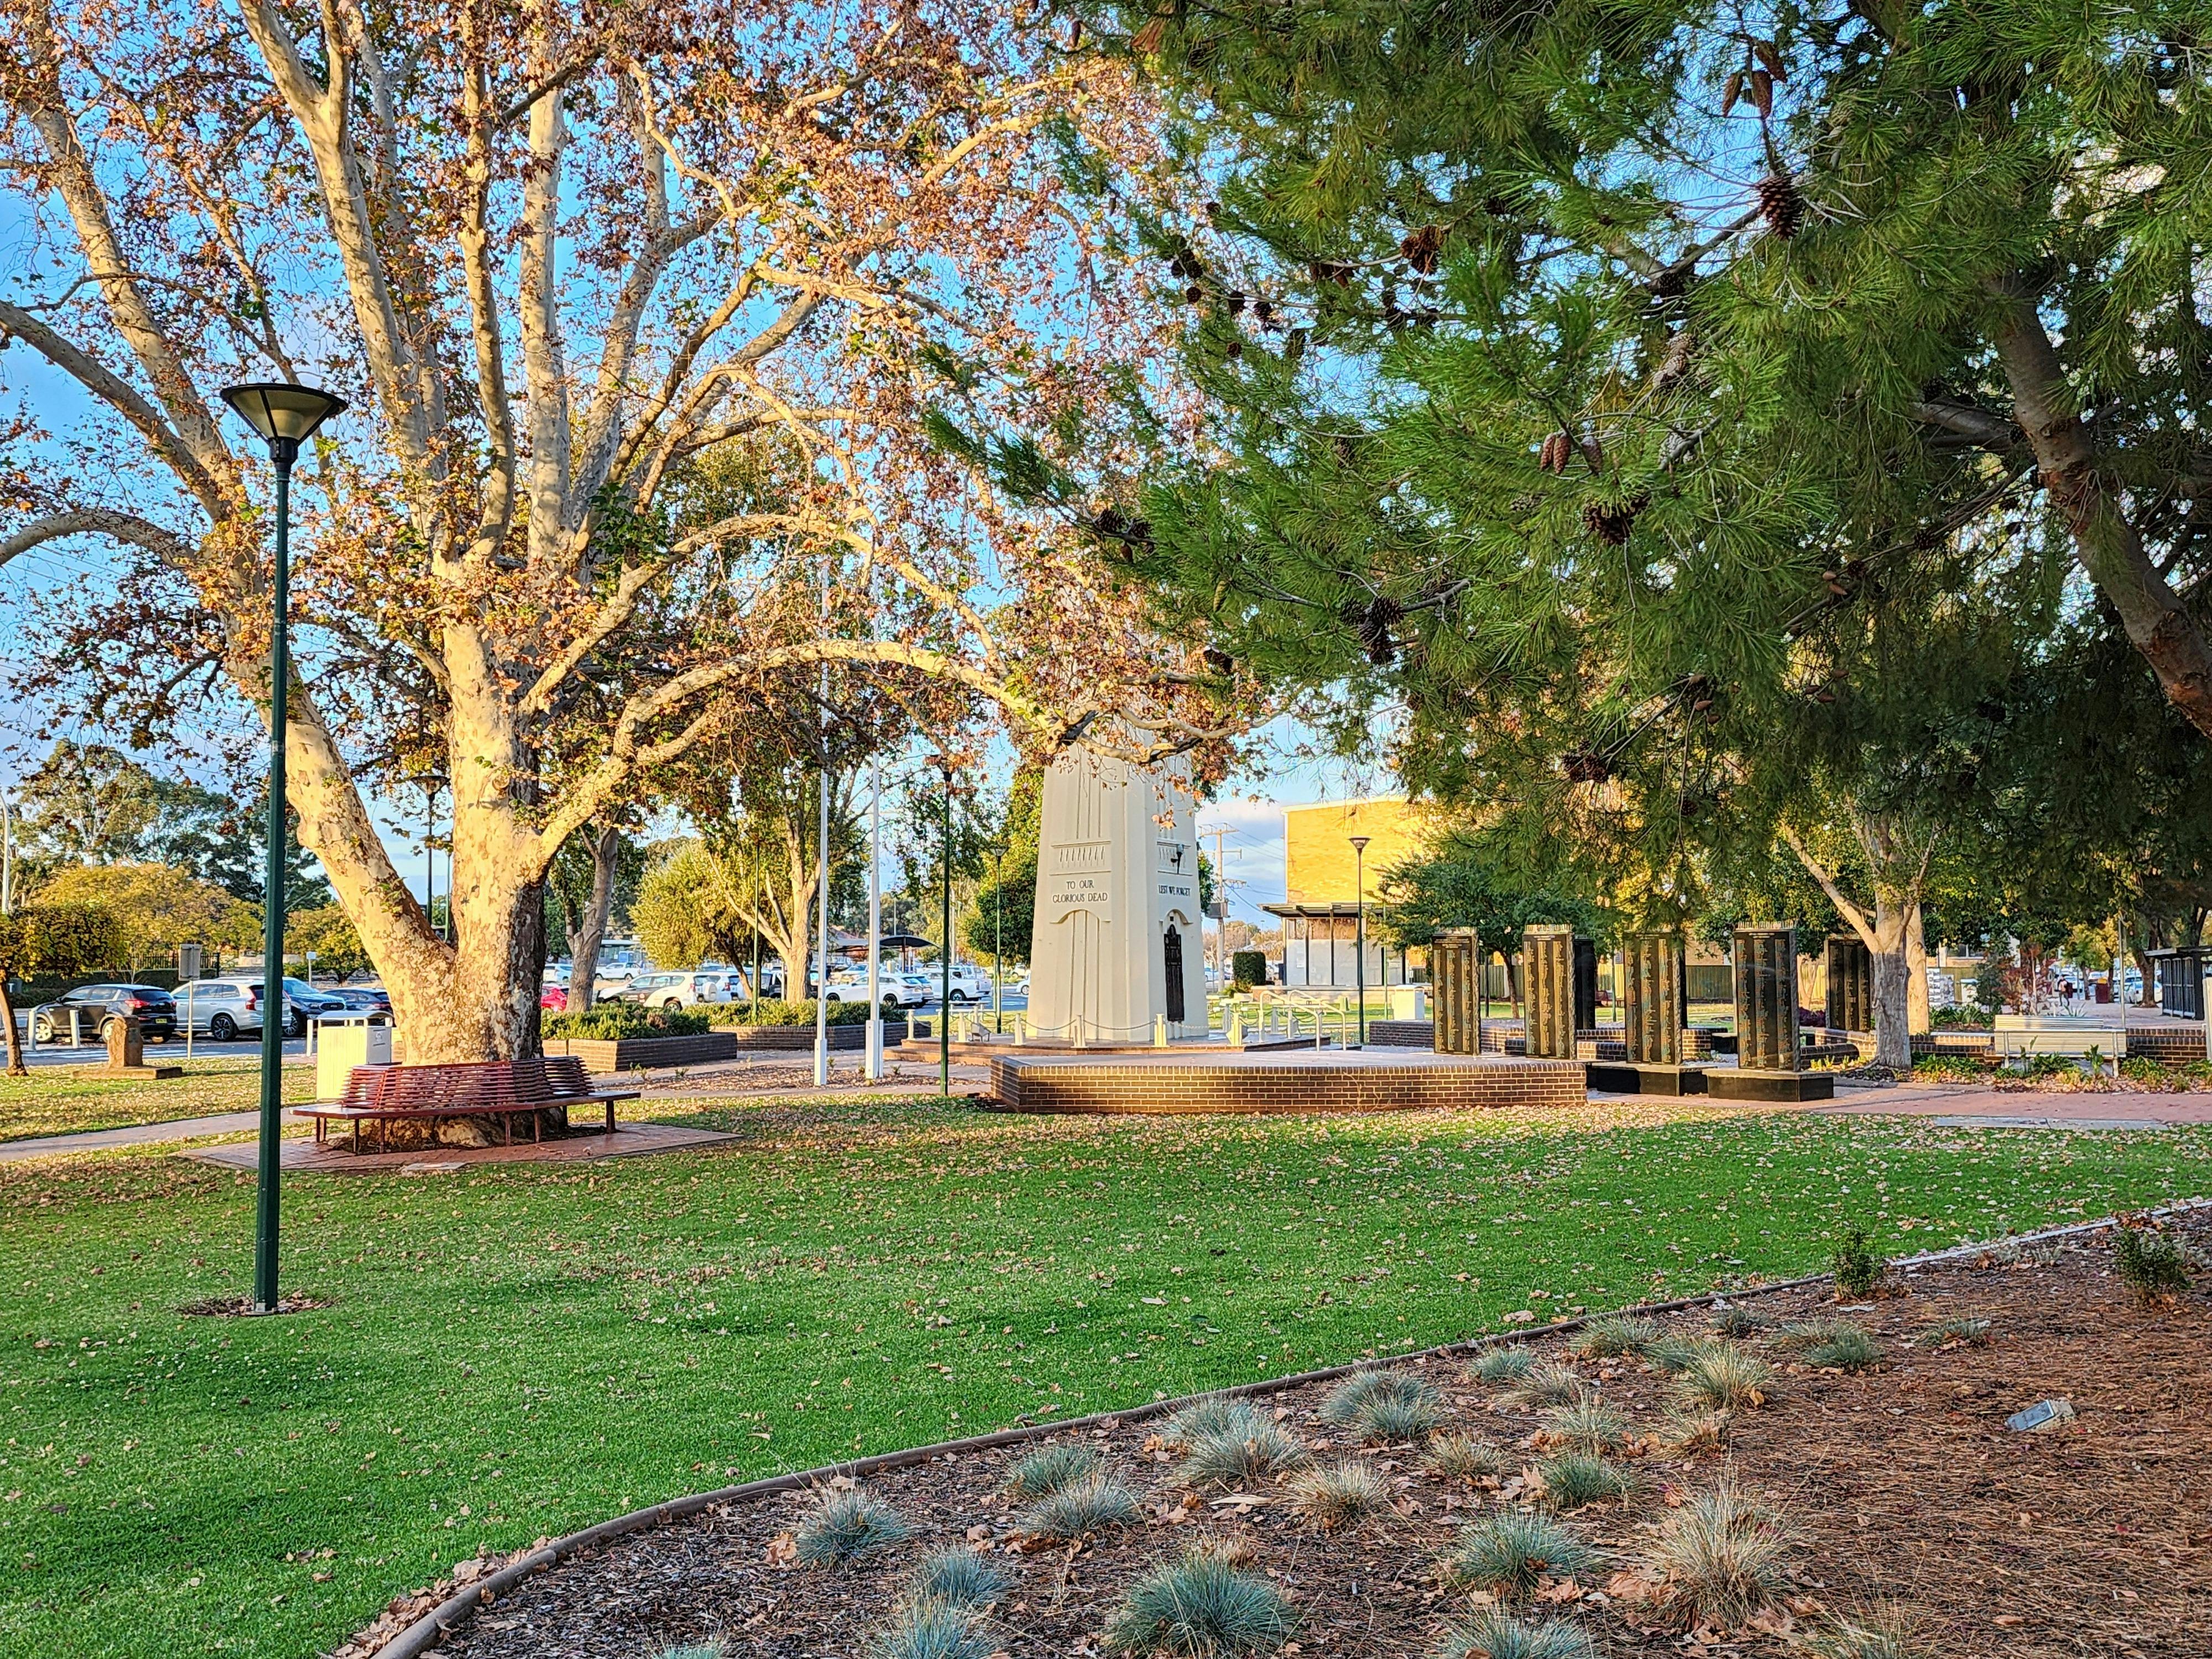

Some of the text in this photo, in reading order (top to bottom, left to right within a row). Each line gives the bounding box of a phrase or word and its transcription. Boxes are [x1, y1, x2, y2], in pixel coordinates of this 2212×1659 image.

[1066, 879, 1094, 890] TO OUR
[1158, 884, 1168, 894] LEST
[1052, 892, 1108, 903] GLORIOUS DEAD
